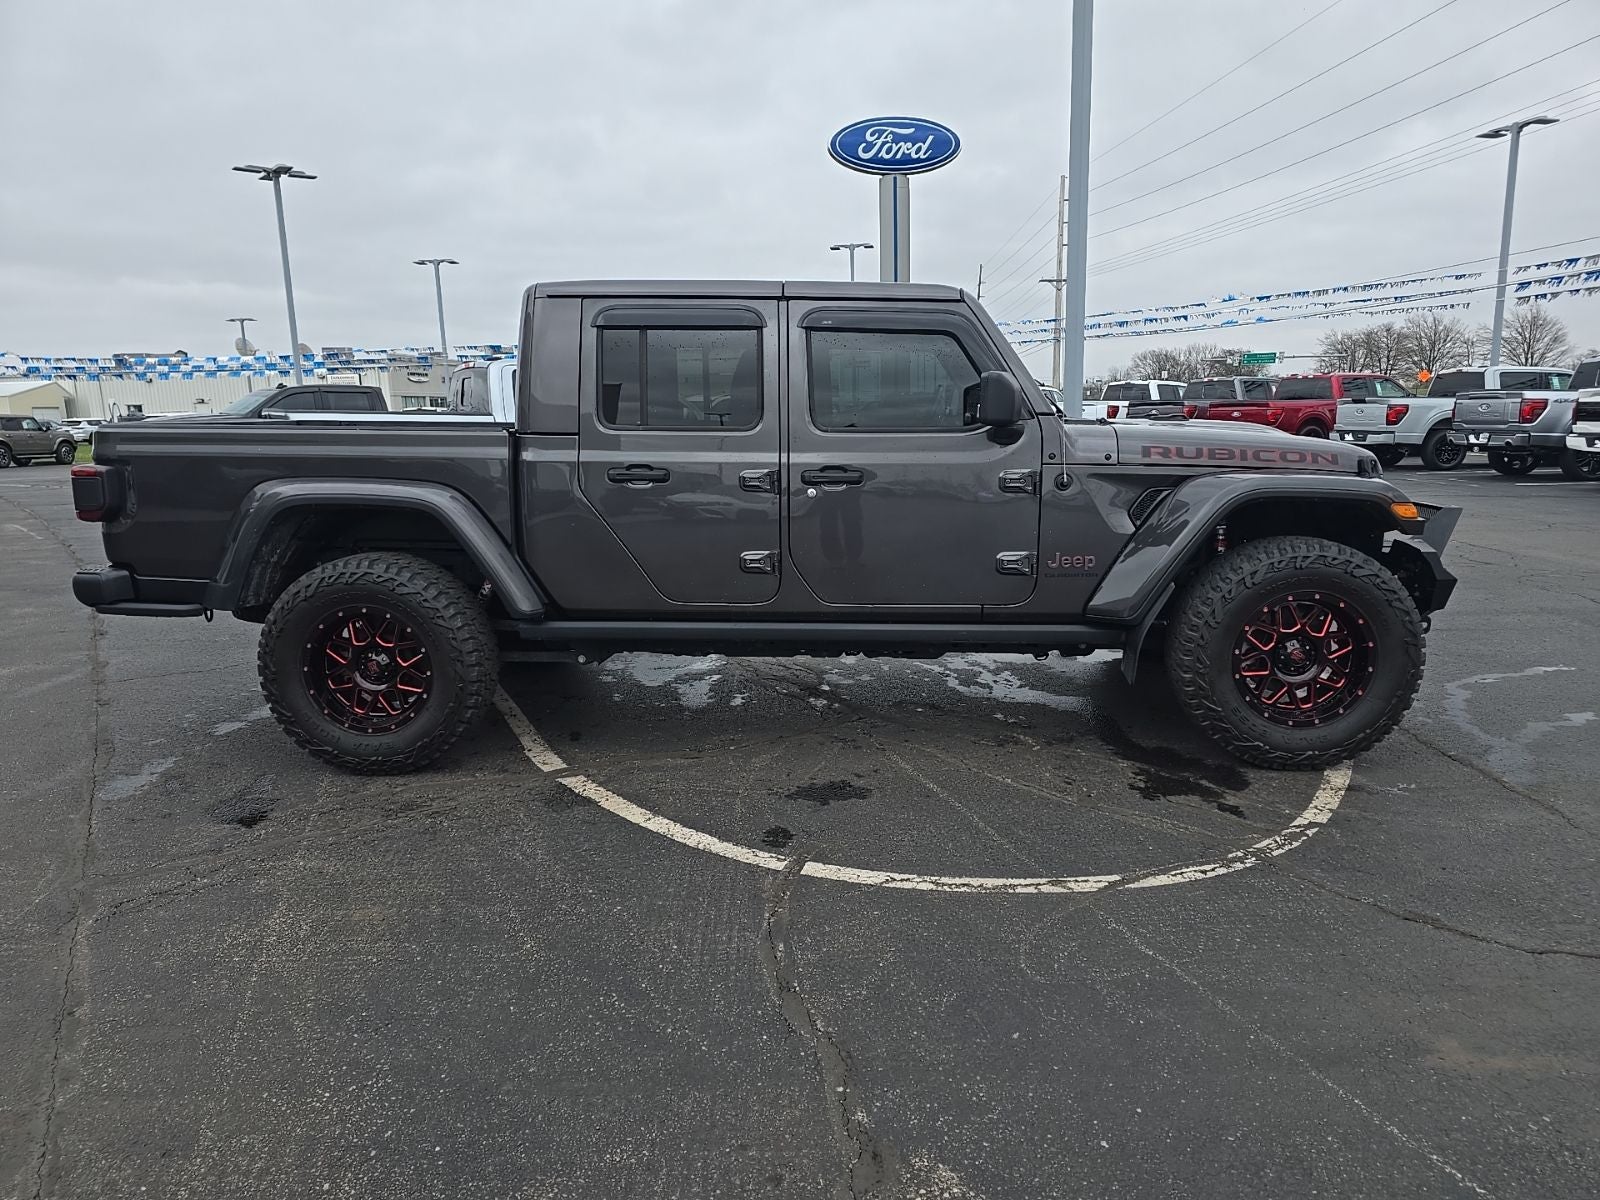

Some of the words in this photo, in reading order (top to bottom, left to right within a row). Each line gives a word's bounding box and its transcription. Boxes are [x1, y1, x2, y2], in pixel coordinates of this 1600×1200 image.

[858, 126, 934, 159] Ford
[1141, 445, 1339, 465] RUBICON
[1047, 552, 1096, 571] Jeep
